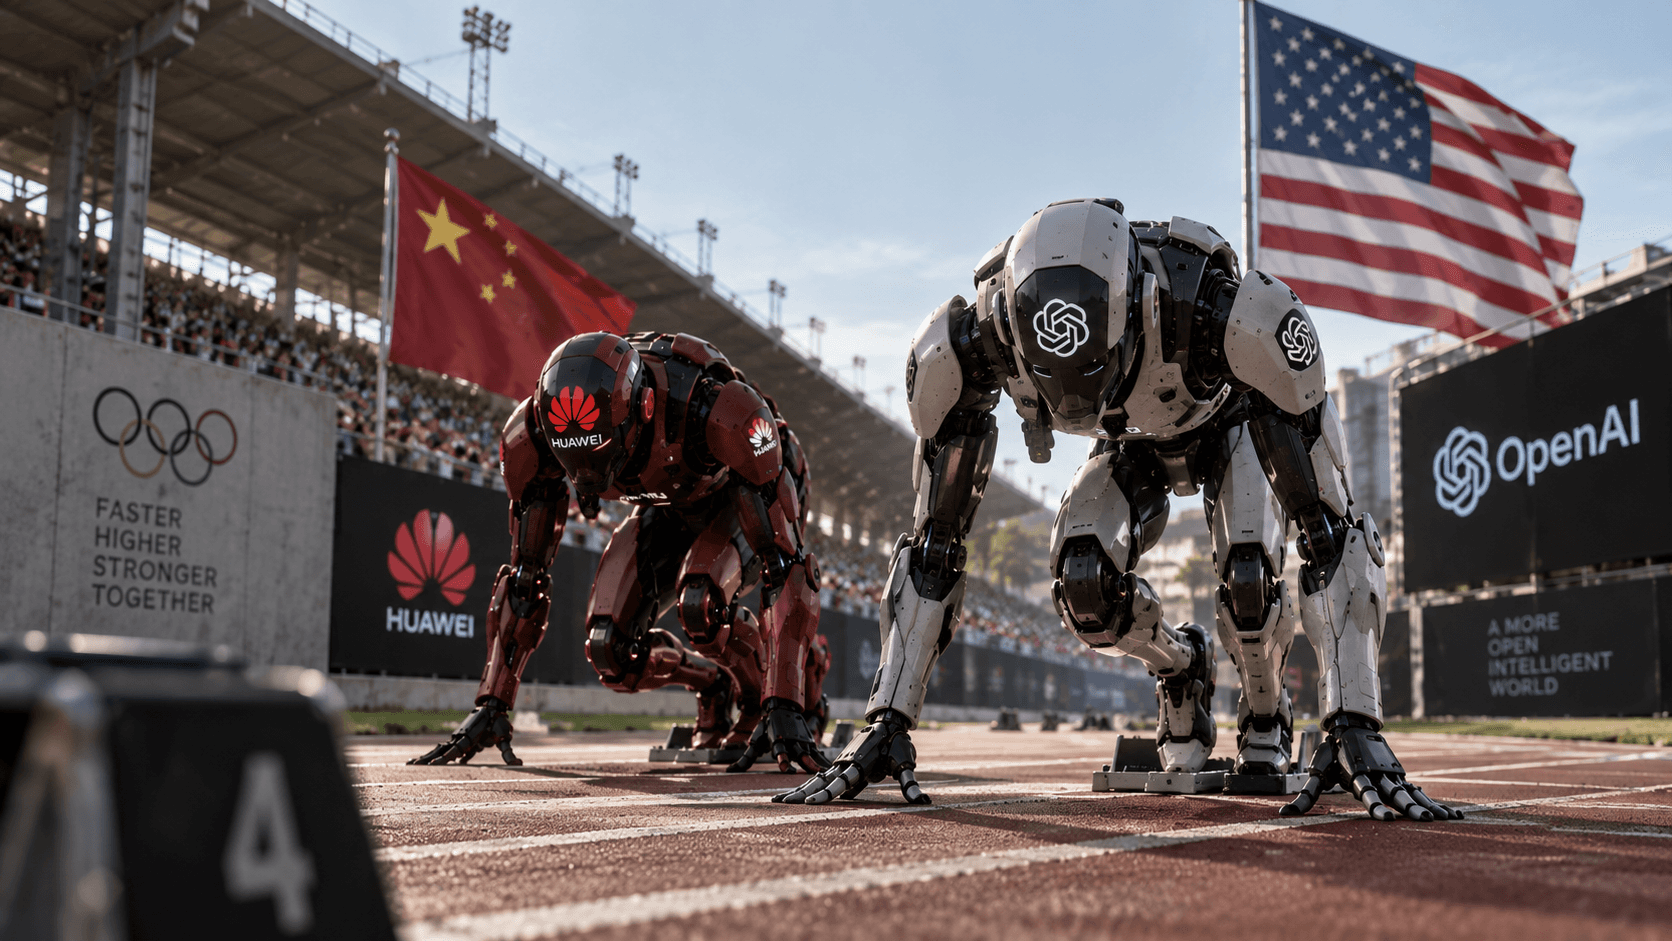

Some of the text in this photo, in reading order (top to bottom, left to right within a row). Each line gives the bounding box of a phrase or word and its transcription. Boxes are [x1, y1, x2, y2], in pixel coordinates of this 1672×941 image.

[551, 433, 603, 449] HUAWEI
[1496, 398, 1641, 487] OpenAI
[95, 498, 182, 530] FASTER
[94, 526, 182, 557] HIGHER
[92, 555, 218, 589] STRONGER
[91, 583, 214, 615] TOGETHER
[385, 606, 475, 639] HUAWEI
[1487, 611, 1560, 636] A MORE
[1487, 635, 1539, 657] OPEN
[1488, 651, 1613, 677] INTELLIGENT
[1488, 676, 1559, 697] WORLD
[223, 751, 315, 935] 4
